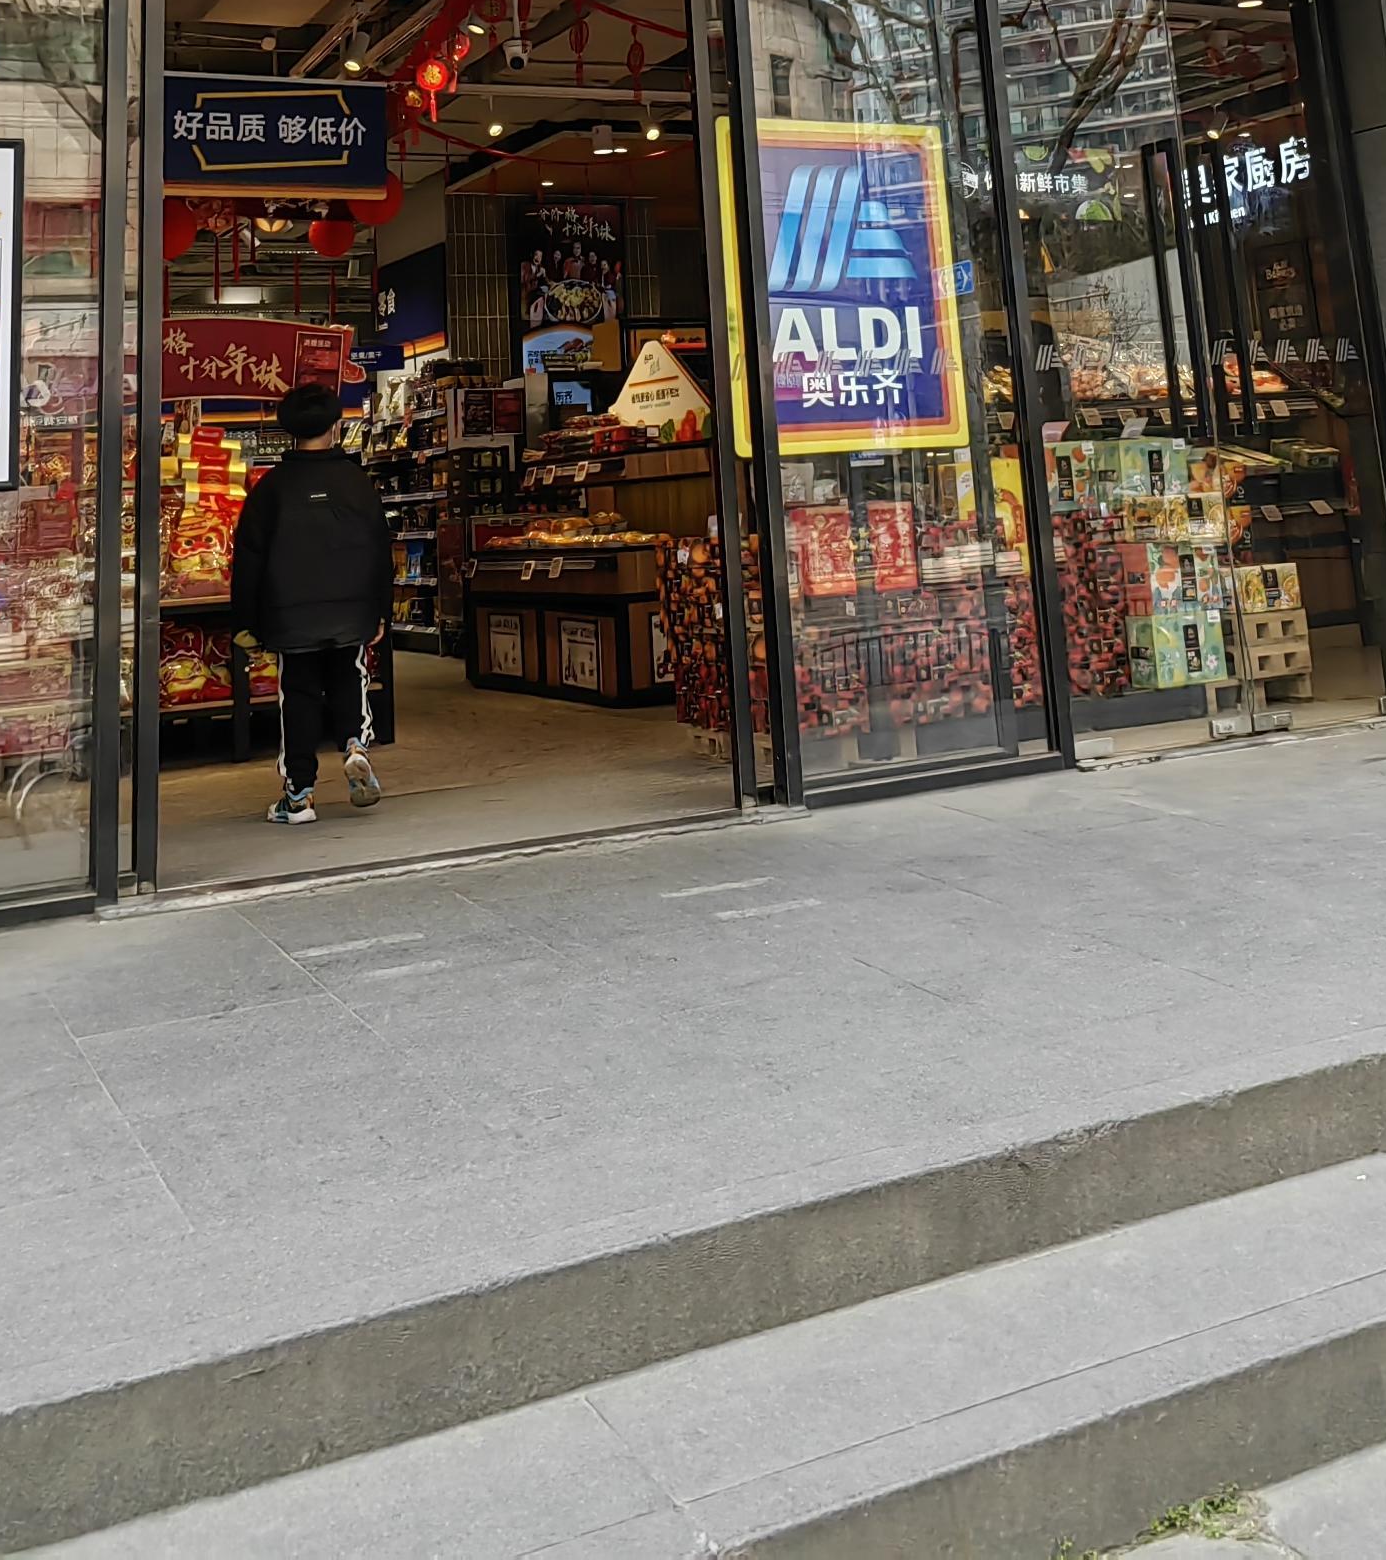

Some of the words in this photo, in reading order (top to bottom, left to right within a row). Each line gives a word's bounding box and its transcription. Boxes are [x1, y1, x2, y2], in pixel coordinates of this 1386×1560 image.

[173, 109, 266, 144] 好品质
[277, 115, 367, 148] 够低价
[772, 305, 922, 361] ALDI
[180, 343, 294, 393] 十分年味
[801, 367, 904, 407] 奥乐齐
